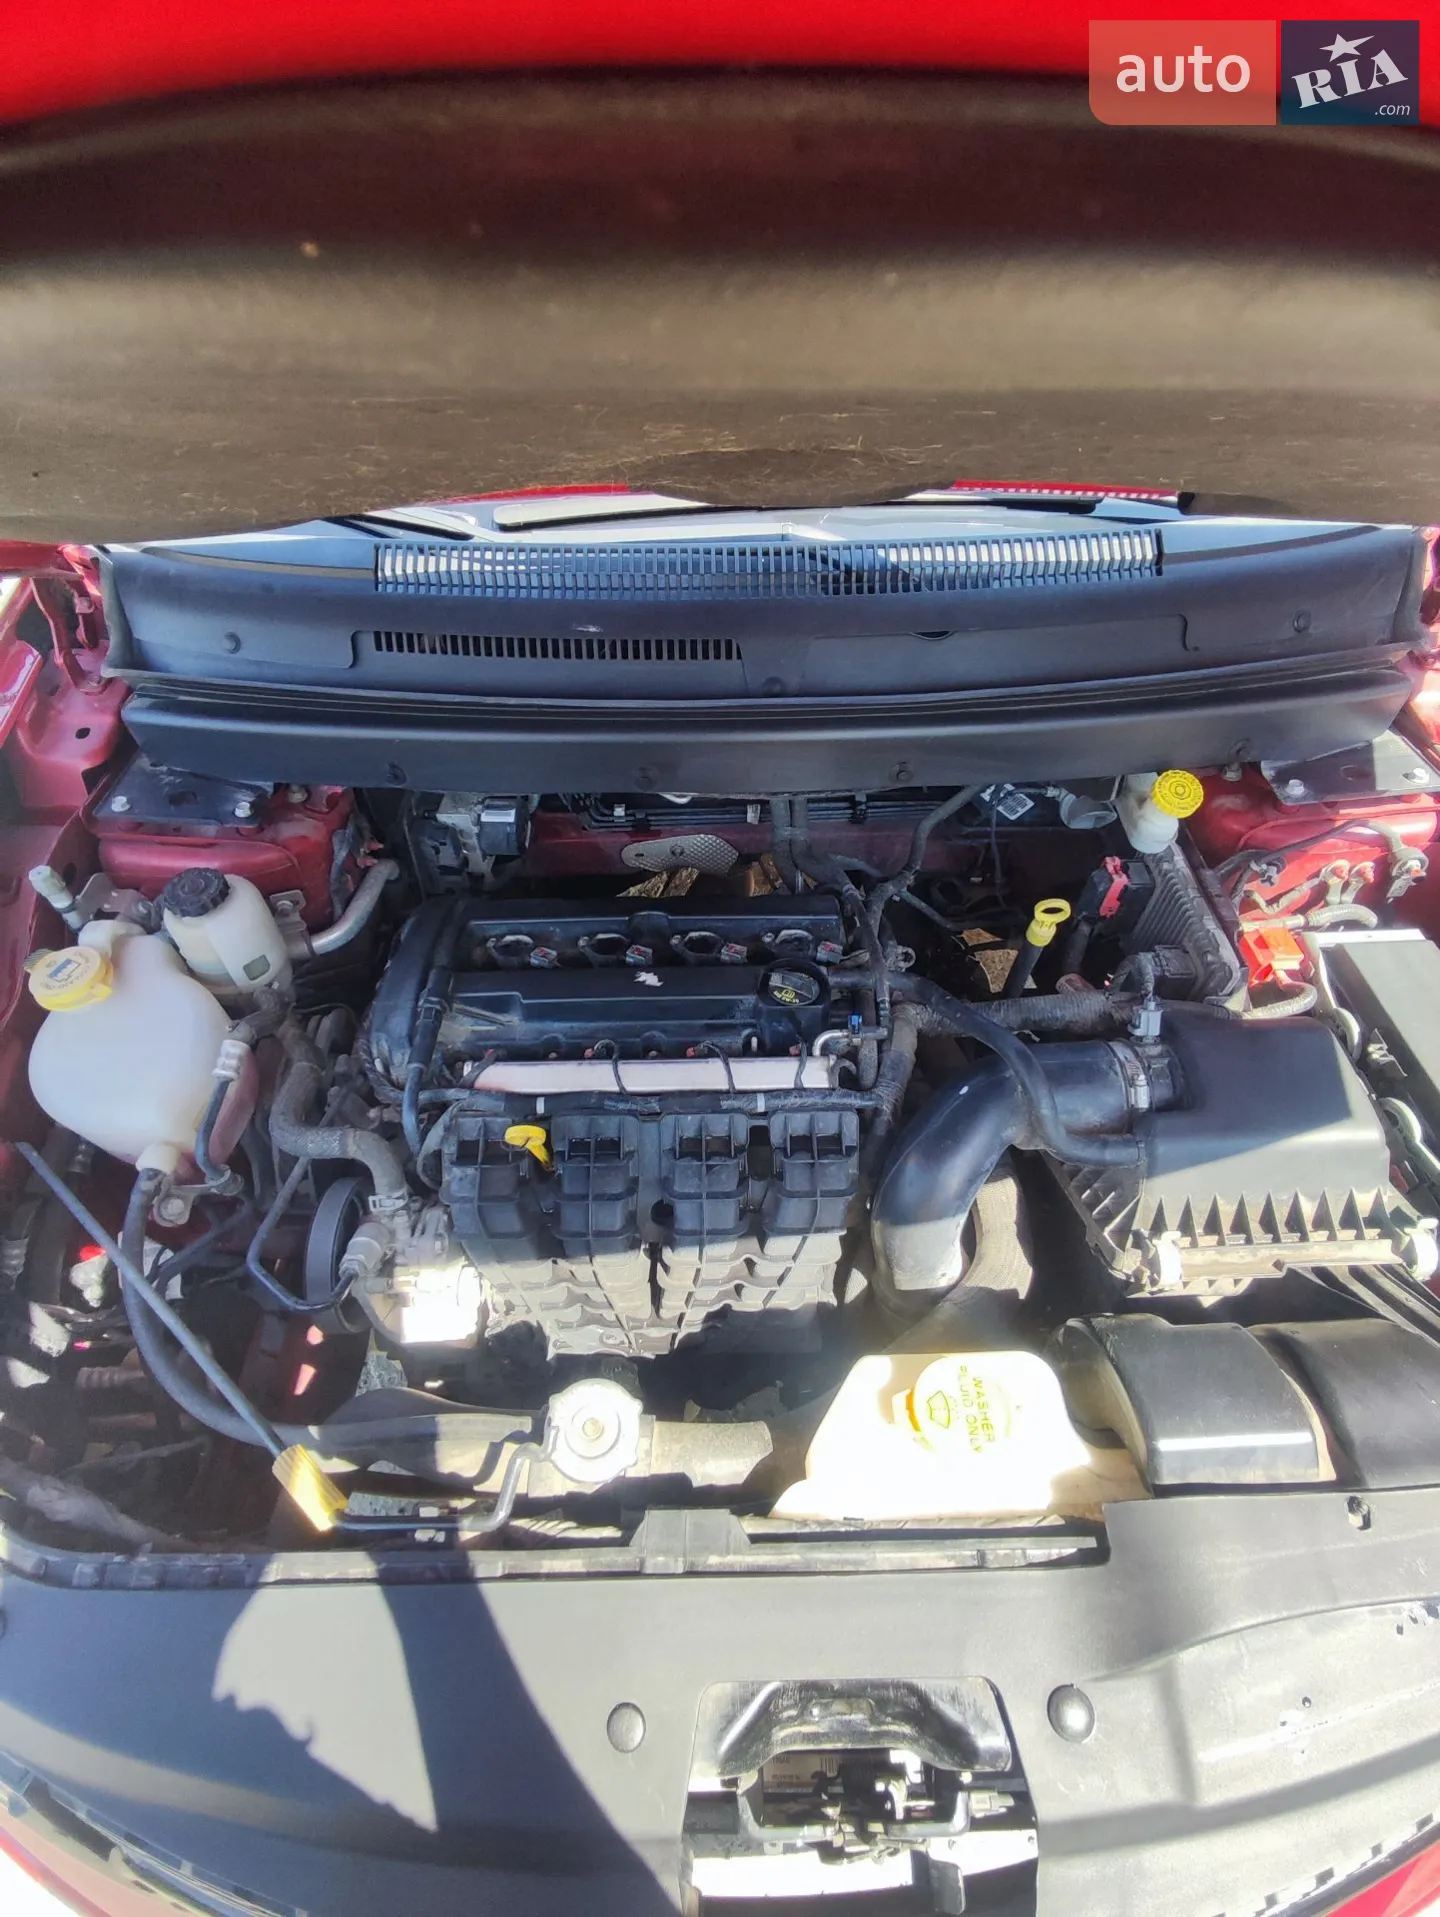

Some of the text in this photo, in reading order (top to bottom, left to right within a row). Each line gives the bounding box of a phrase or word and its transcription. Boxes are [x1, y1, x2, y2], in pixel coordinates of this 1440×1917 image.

[958, 1365, 983, 1453] FLUID ONLY
[972, 1376, 996, 1443] WASHER
